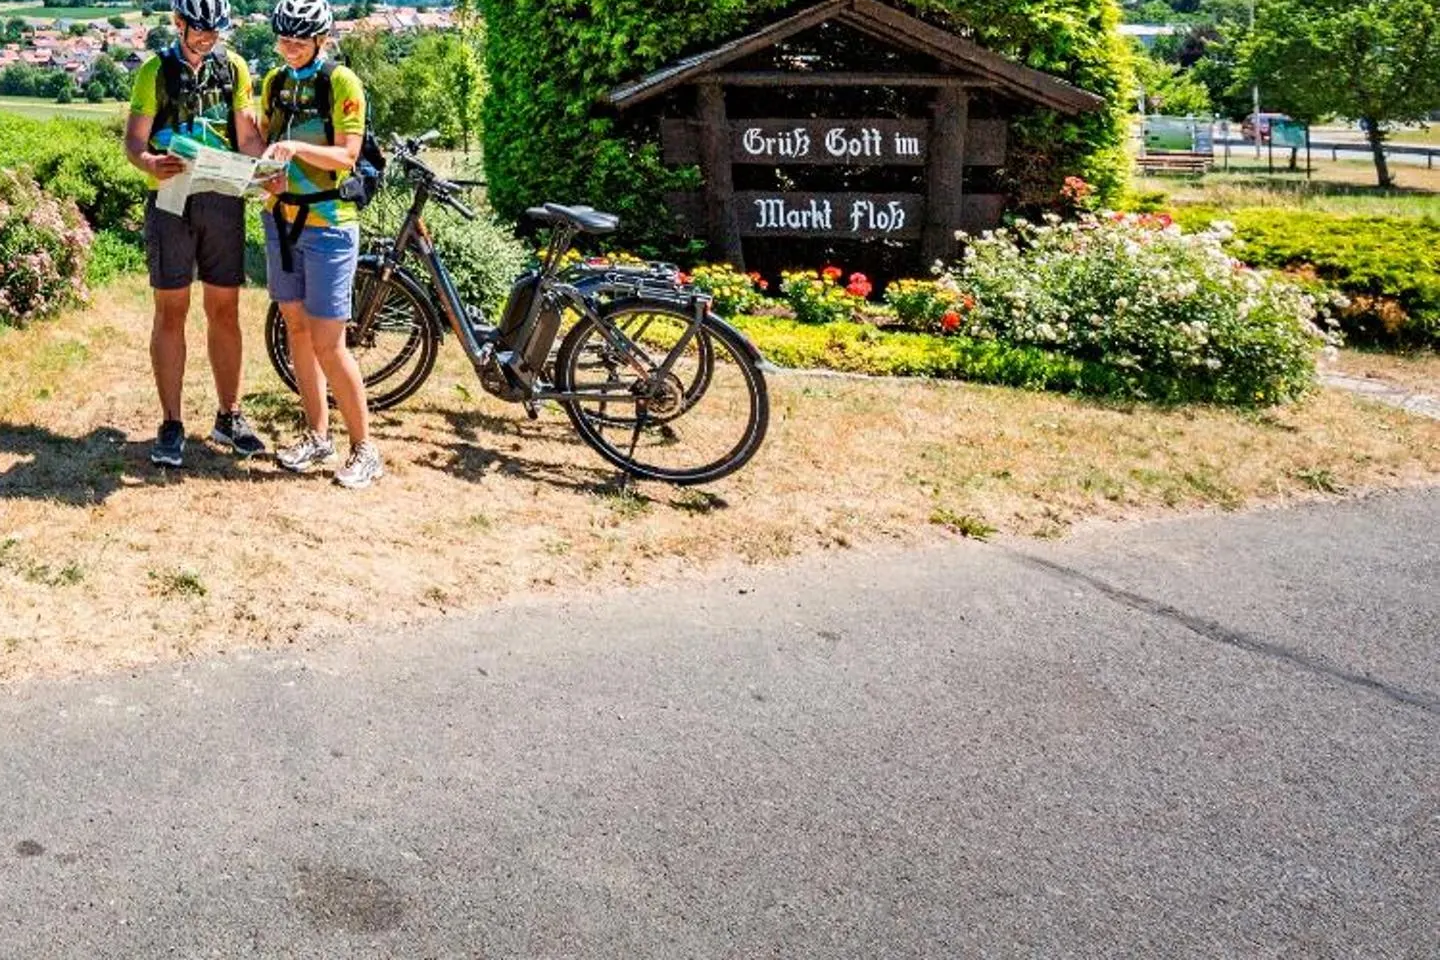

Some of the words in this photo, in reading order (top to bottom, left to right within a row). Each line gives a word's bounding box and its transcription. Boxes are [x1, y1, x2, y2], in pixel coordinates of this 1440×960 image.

[743, 128, 810, 157] Grüß
[825, 127, 882, 157] Gott
[894, 131, 919, 156] im
[754, 199, 832, 229] Markt
[849, 199, 905, 232] Floß
